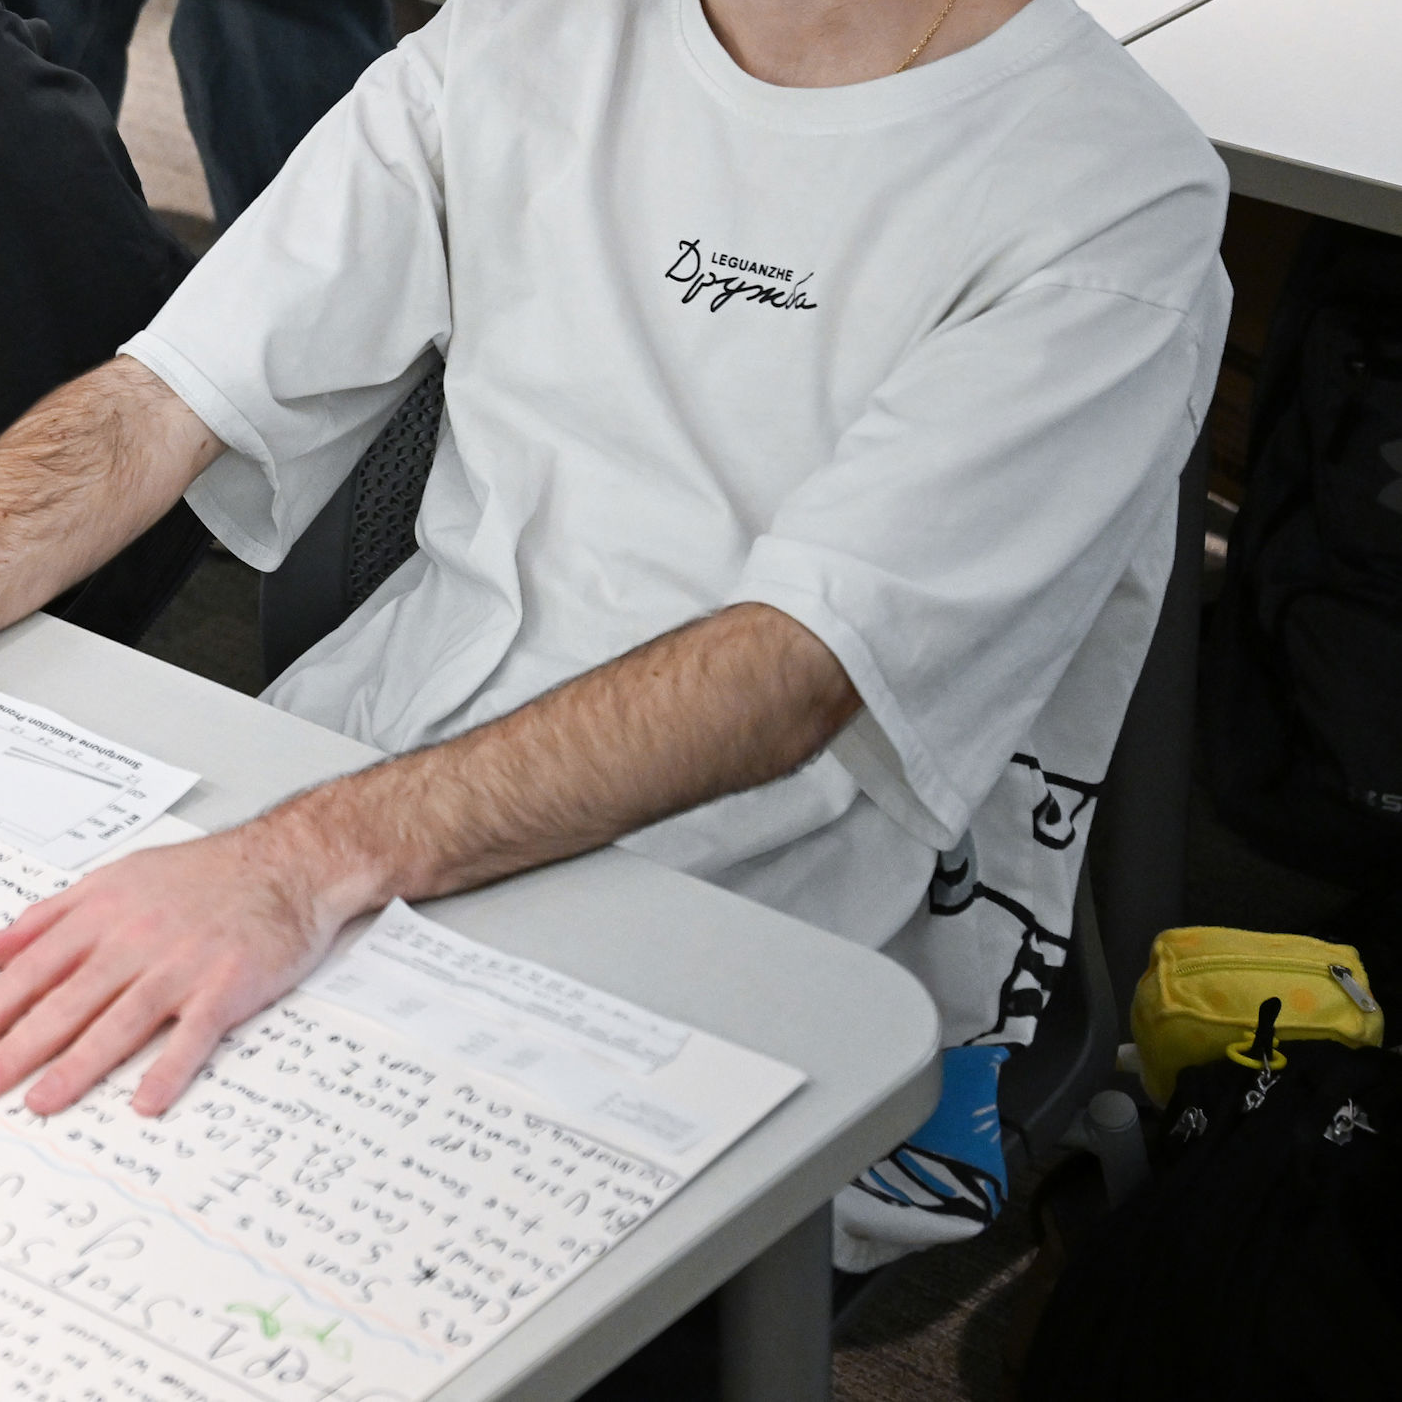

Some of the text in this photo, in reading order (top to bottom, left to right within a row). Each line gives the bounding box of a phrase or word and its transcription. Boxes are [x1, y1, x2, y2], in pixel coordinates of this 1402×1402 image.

[711, 252, 794, 282] LEGUANZHE
[28, 718, 77, 742] Addiction
[79, 739, 142, 770] Smartphone
